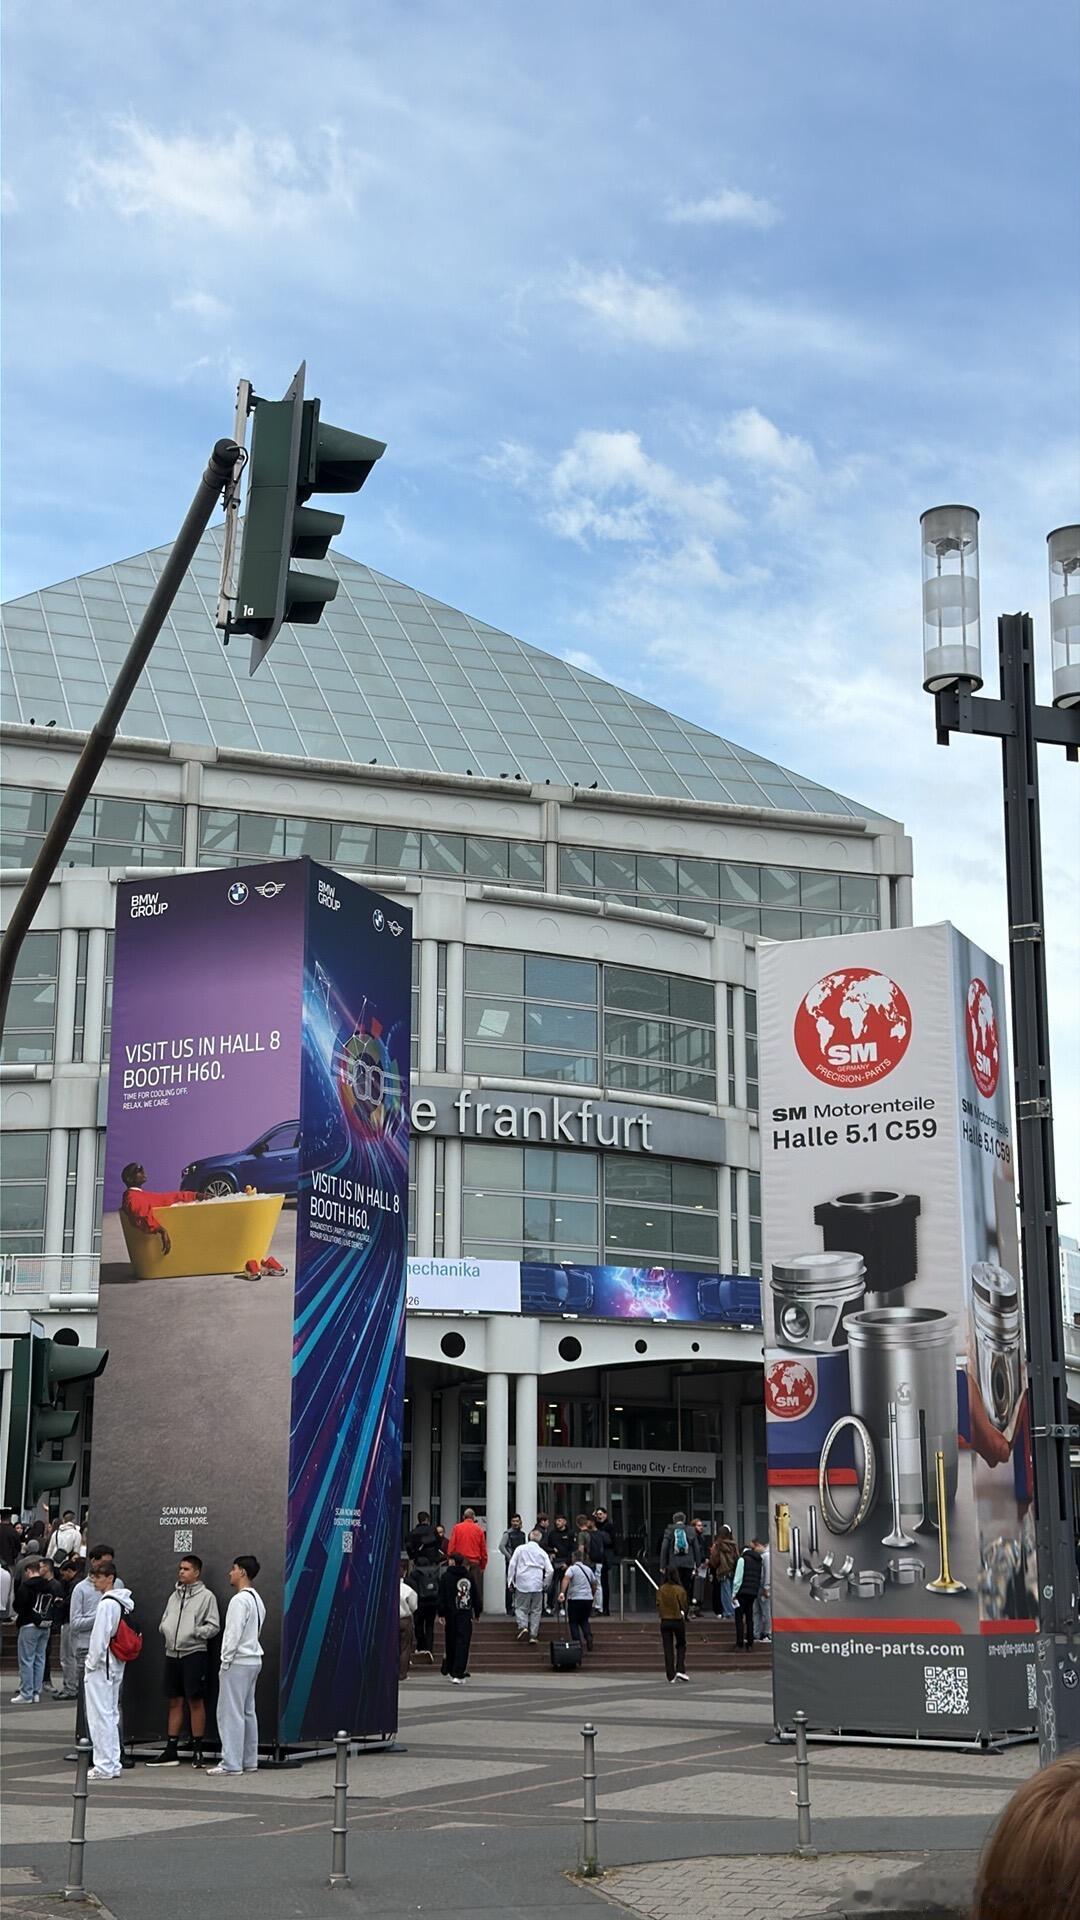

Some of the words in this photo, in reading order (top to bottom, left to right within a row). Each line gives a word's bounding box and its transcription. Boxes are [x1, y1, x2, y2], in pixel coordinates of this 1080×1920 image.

[243, 605, 254, 616] 1a
[318, 879, 336, 898] BMW
[131, 892, 159, 907] BMW
[318, 892, 341, 911] GROUP
[130, 903, 168, 918] GROUP
[125, 1041, 168, 1064] VISIT
[171, 1038, 194, 1059] US
[199, 1036, 215, 1056] IN
[220, 1032, 265, 1054] HALL
[269, 1030, 280, 1050] 8
[828, 1042, 878, 1066] SM
[815, 1058, 892, 1084] PRECISION-PARTS
[837, 1063, 870, 1072] GERMANY
[975, 1050, 992, 1077] SM
[123, 1064, 182, 1089] BOOTH
[187, 1060, 225, 1082] H60.
[123, 1092, 137, 1101] TIME
[137, 1091, 150, 1100] FOR
[150, 1088, 175, 1098] COOLING
[143, 1100, 153, 1108] WE
[772, 1106, 807, 1122] SM
[814, 1096, 935, 1118] Motorenteile
[961, 1098, 973, 1117] SM
[453, 1089, 653, 1150] frankfurt
[773, 1126, 838, 1150] Halle
[846, 1122, 877, 1144] 5.1
[885, 1118, 938, 1141] C59
[962, 1120, 983, 1149] Halle
[983, 1132, 994, 1155] 5.1
[995, 1140, 1011, 1164] C59
[311, 1170, 338, 1196] VISIT
[338, 1178, 352, 1200] US
[354, 1182, 364, 1204] IN
[366, 1186, 392, 1212] HALL
[393, 1194, 400, 1214] 8
[310, 1196, 346, 1224] BOOTH
[347, 1206, 370, 1231] H60.
[776, 1396, 800, 1407] SM
[613, 1460, 647, 1473] Eingang
[649, 1461, 665, 1473] City
[673, 1463, 707, 1474] Entrance
[162, 1506, 179, 1515] SCAN
[179, 1506, 193, 1515] NOW
[194, 1506, 208, 1515] AND
[160, 1516, 189, 1525] DISCOVER
[190, 1516, 209, 1525] MORE.
[790, 1639, 965, 1658] sm-engine-parts.com
[988, 1640, 1035, 1658] sm-engine-parts.co
